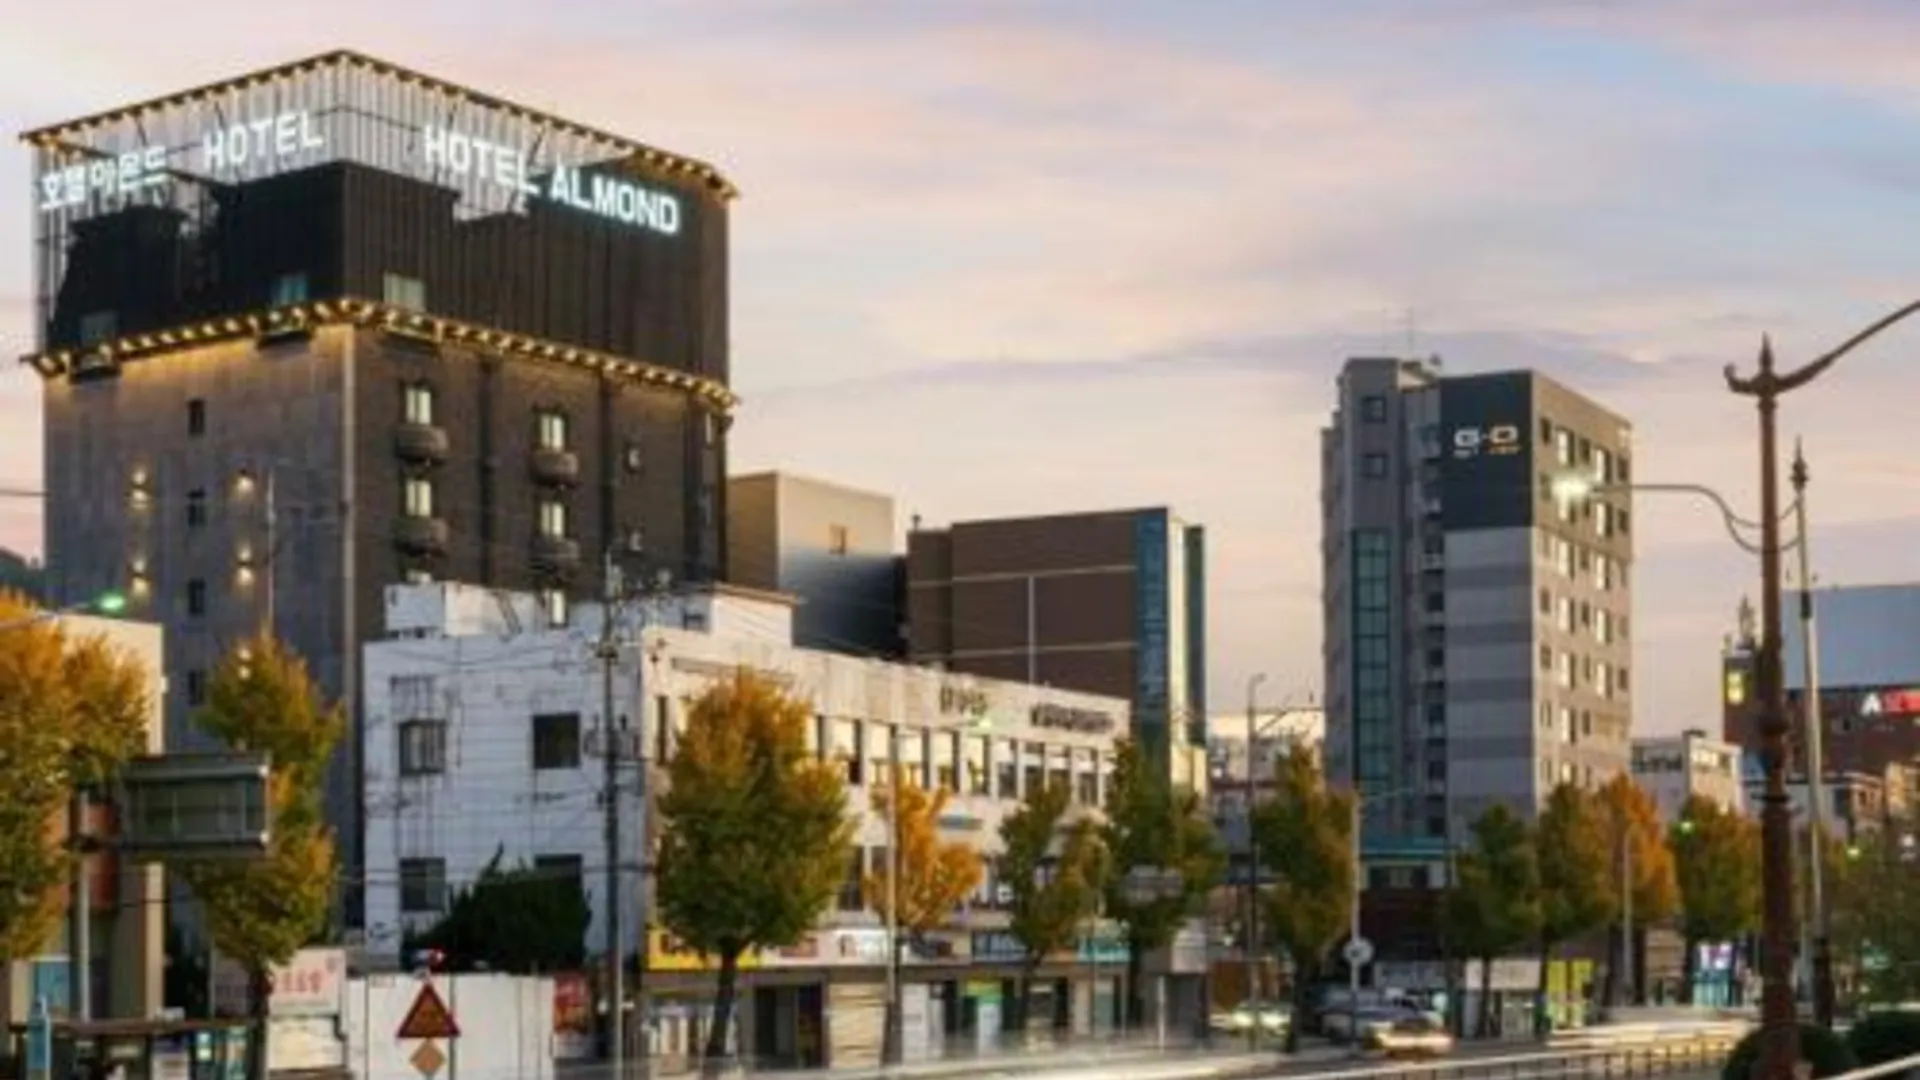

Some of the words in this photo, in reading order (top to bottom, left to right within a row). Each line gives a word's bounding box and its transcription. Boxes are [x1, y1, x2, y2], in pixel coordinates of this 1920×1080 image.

[203, 109, 324, 169] HOTEL
[424, 125, 541, 196] HOTEL
[550, 163, 679, 235] ALMOND
